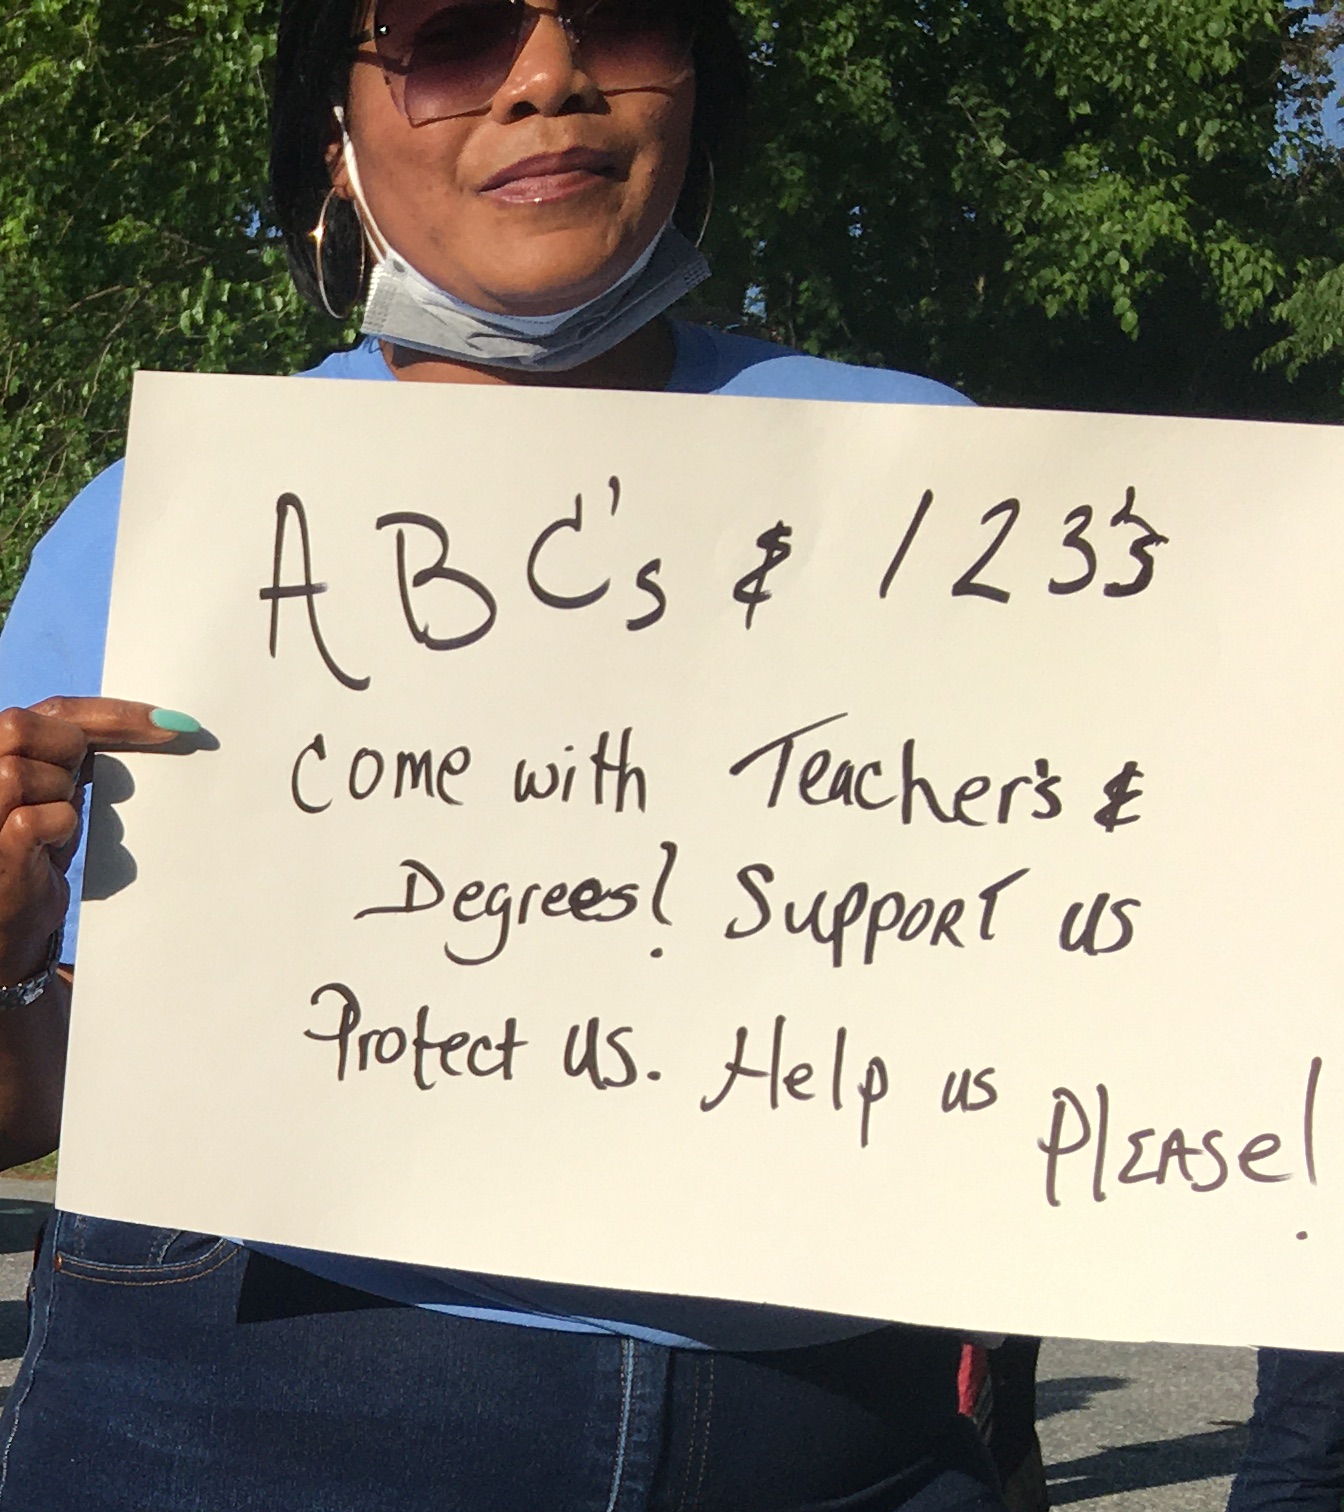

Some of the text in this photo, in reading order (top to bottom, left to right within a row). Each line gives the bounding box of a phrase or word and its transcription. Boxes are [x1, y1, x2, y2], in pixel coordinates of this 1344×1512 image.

[515, 727, 645, 812] with
[730, 713, 1061, 826] Teacher's
[304, 983, 527, 1090] Protect
[701, 1015, 887, 1147] Help
